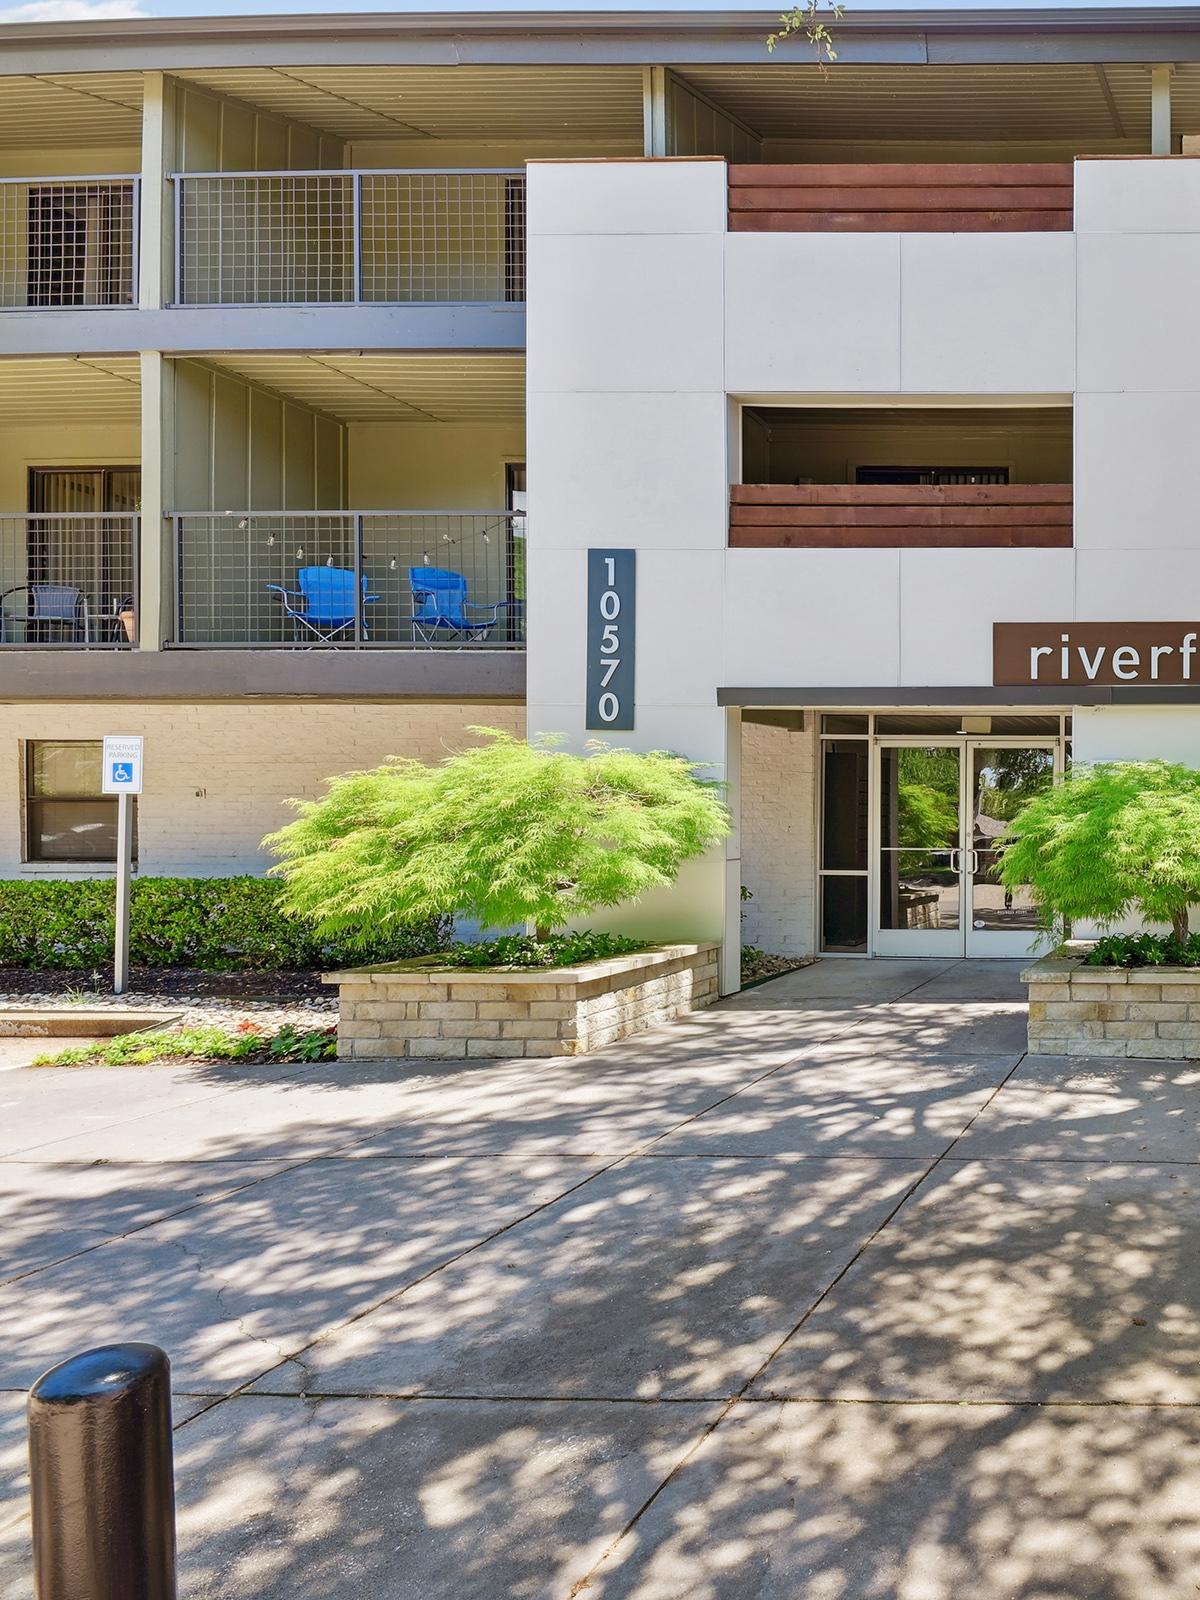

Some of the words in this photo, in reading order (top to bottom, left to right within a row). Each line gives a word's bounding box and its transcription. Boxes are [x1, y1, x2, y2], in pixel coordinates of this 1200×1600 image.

[598, 557, 621, 722] 10570
[106, 743, 140, 751] RESERVED
[109, 751, 138, 759] PARKING
